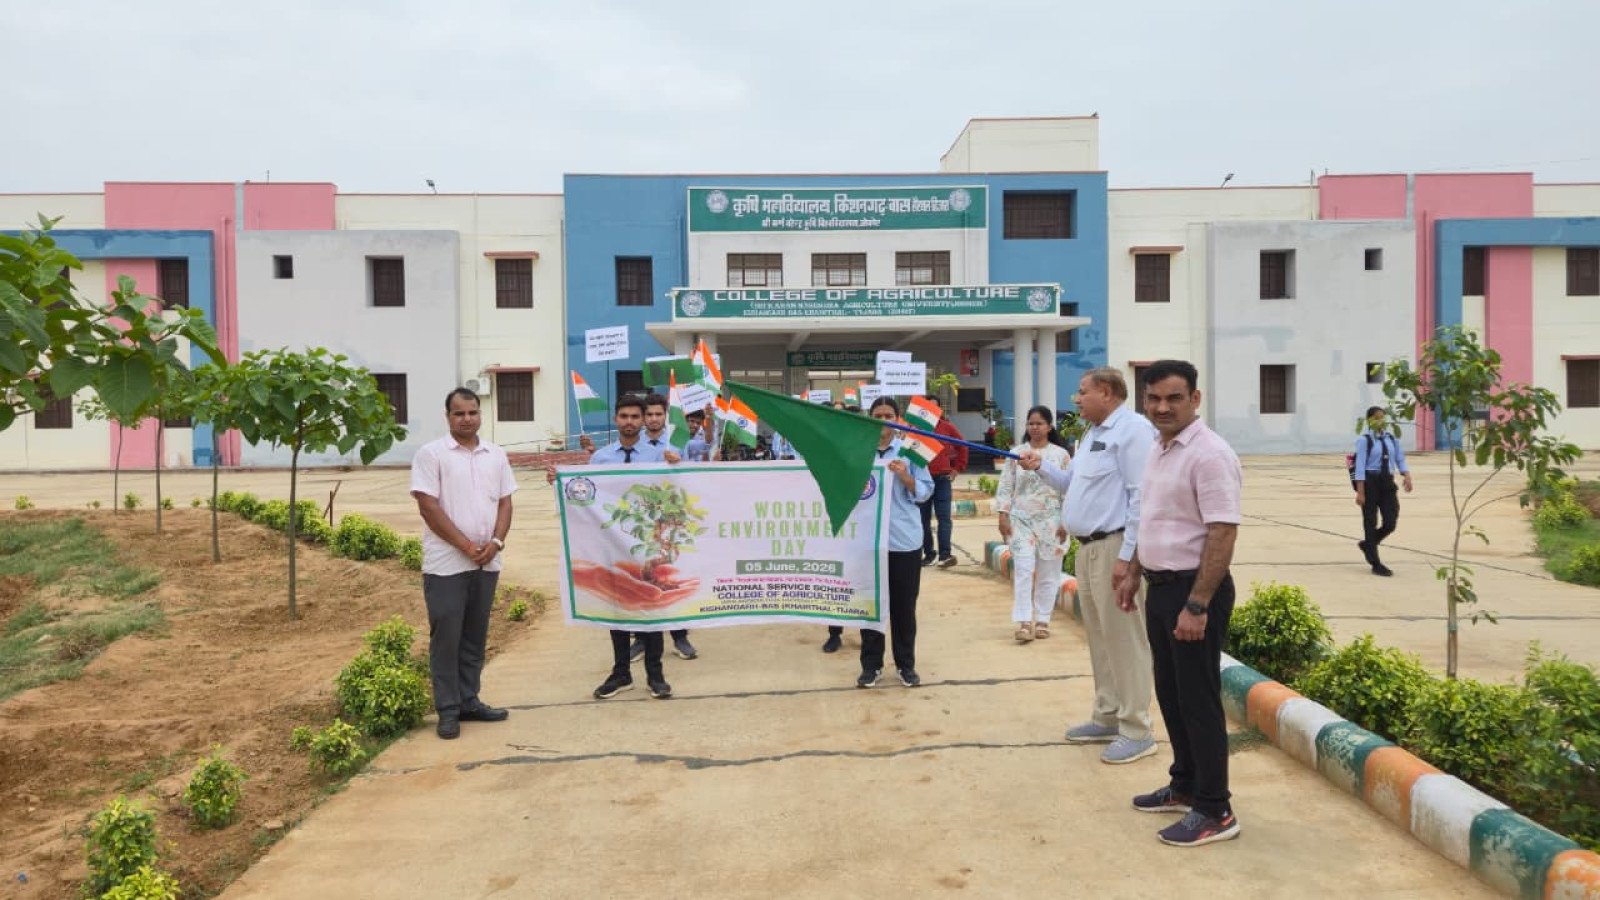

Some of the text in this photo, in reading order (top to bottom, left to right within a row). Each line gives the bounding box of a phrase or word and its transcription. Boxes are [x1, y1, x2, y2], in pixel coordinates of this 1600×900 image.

[732, 194, 759, 217] कृषि
[714, 287, 1021, 300] COLLEGE OF AGRICULTURE
[754, 501, 822, 519] WORLD
[771, 540, 806, 556] DAY
[744, 562, 762, 572] 05
[765, 562, 800, 573] June,
[712, 583, 855, 595] NATIONAL SERVICE SCHEME
[718, 591, 763, 600] COLLEGE
[782, 590, 851, 601] AGRICULTURE
